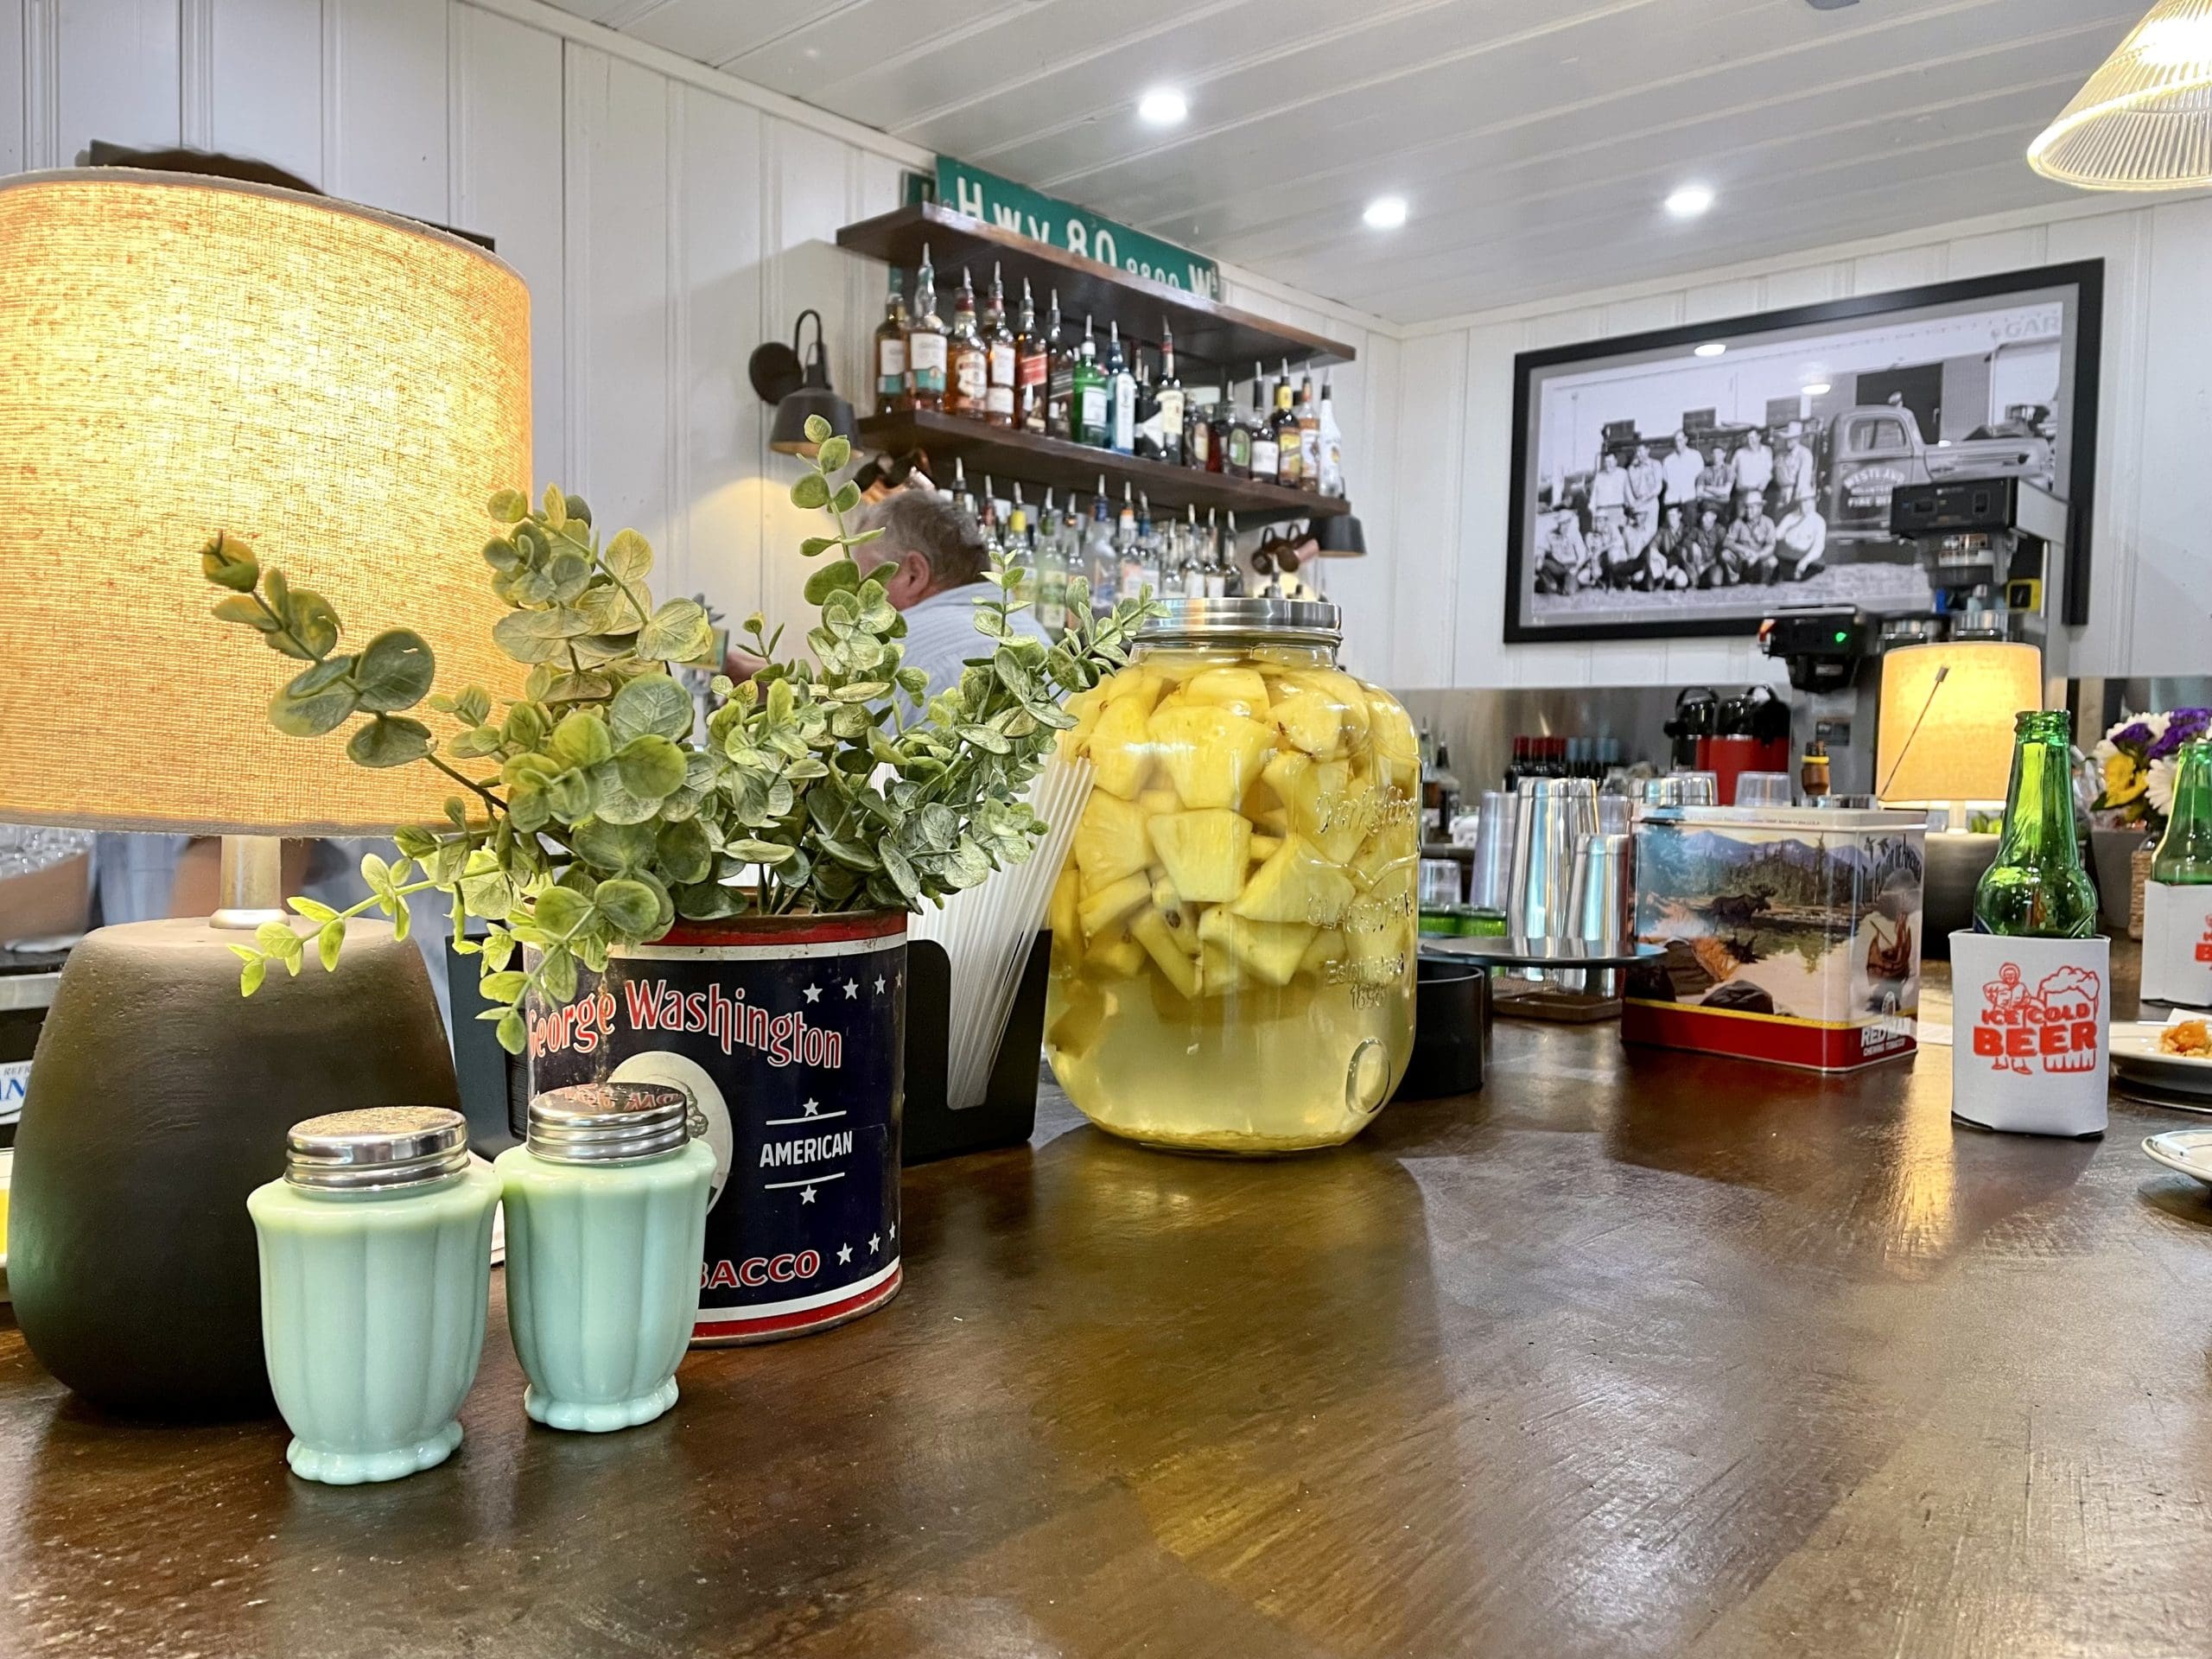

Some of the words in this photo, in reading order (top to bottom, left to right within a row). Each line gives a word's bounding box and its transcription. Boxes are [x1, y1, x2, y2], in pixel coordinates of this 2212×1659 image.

[957, 176, 1049, 244] Hwy
[1066, 219, 1116, 267] 80
[529, 993, 617, 1060] George
[625, 979, 842, 1069] Washington
[1981, 1008, 2019, 1025] ICE
[2027, 1002, 2091, 1024] COLD
[1860, 1025, 1887, 1048] RED
[1973, 1020, 2097, 1058] BEER
[760, 1130, 853, 1167] AMERICAN
